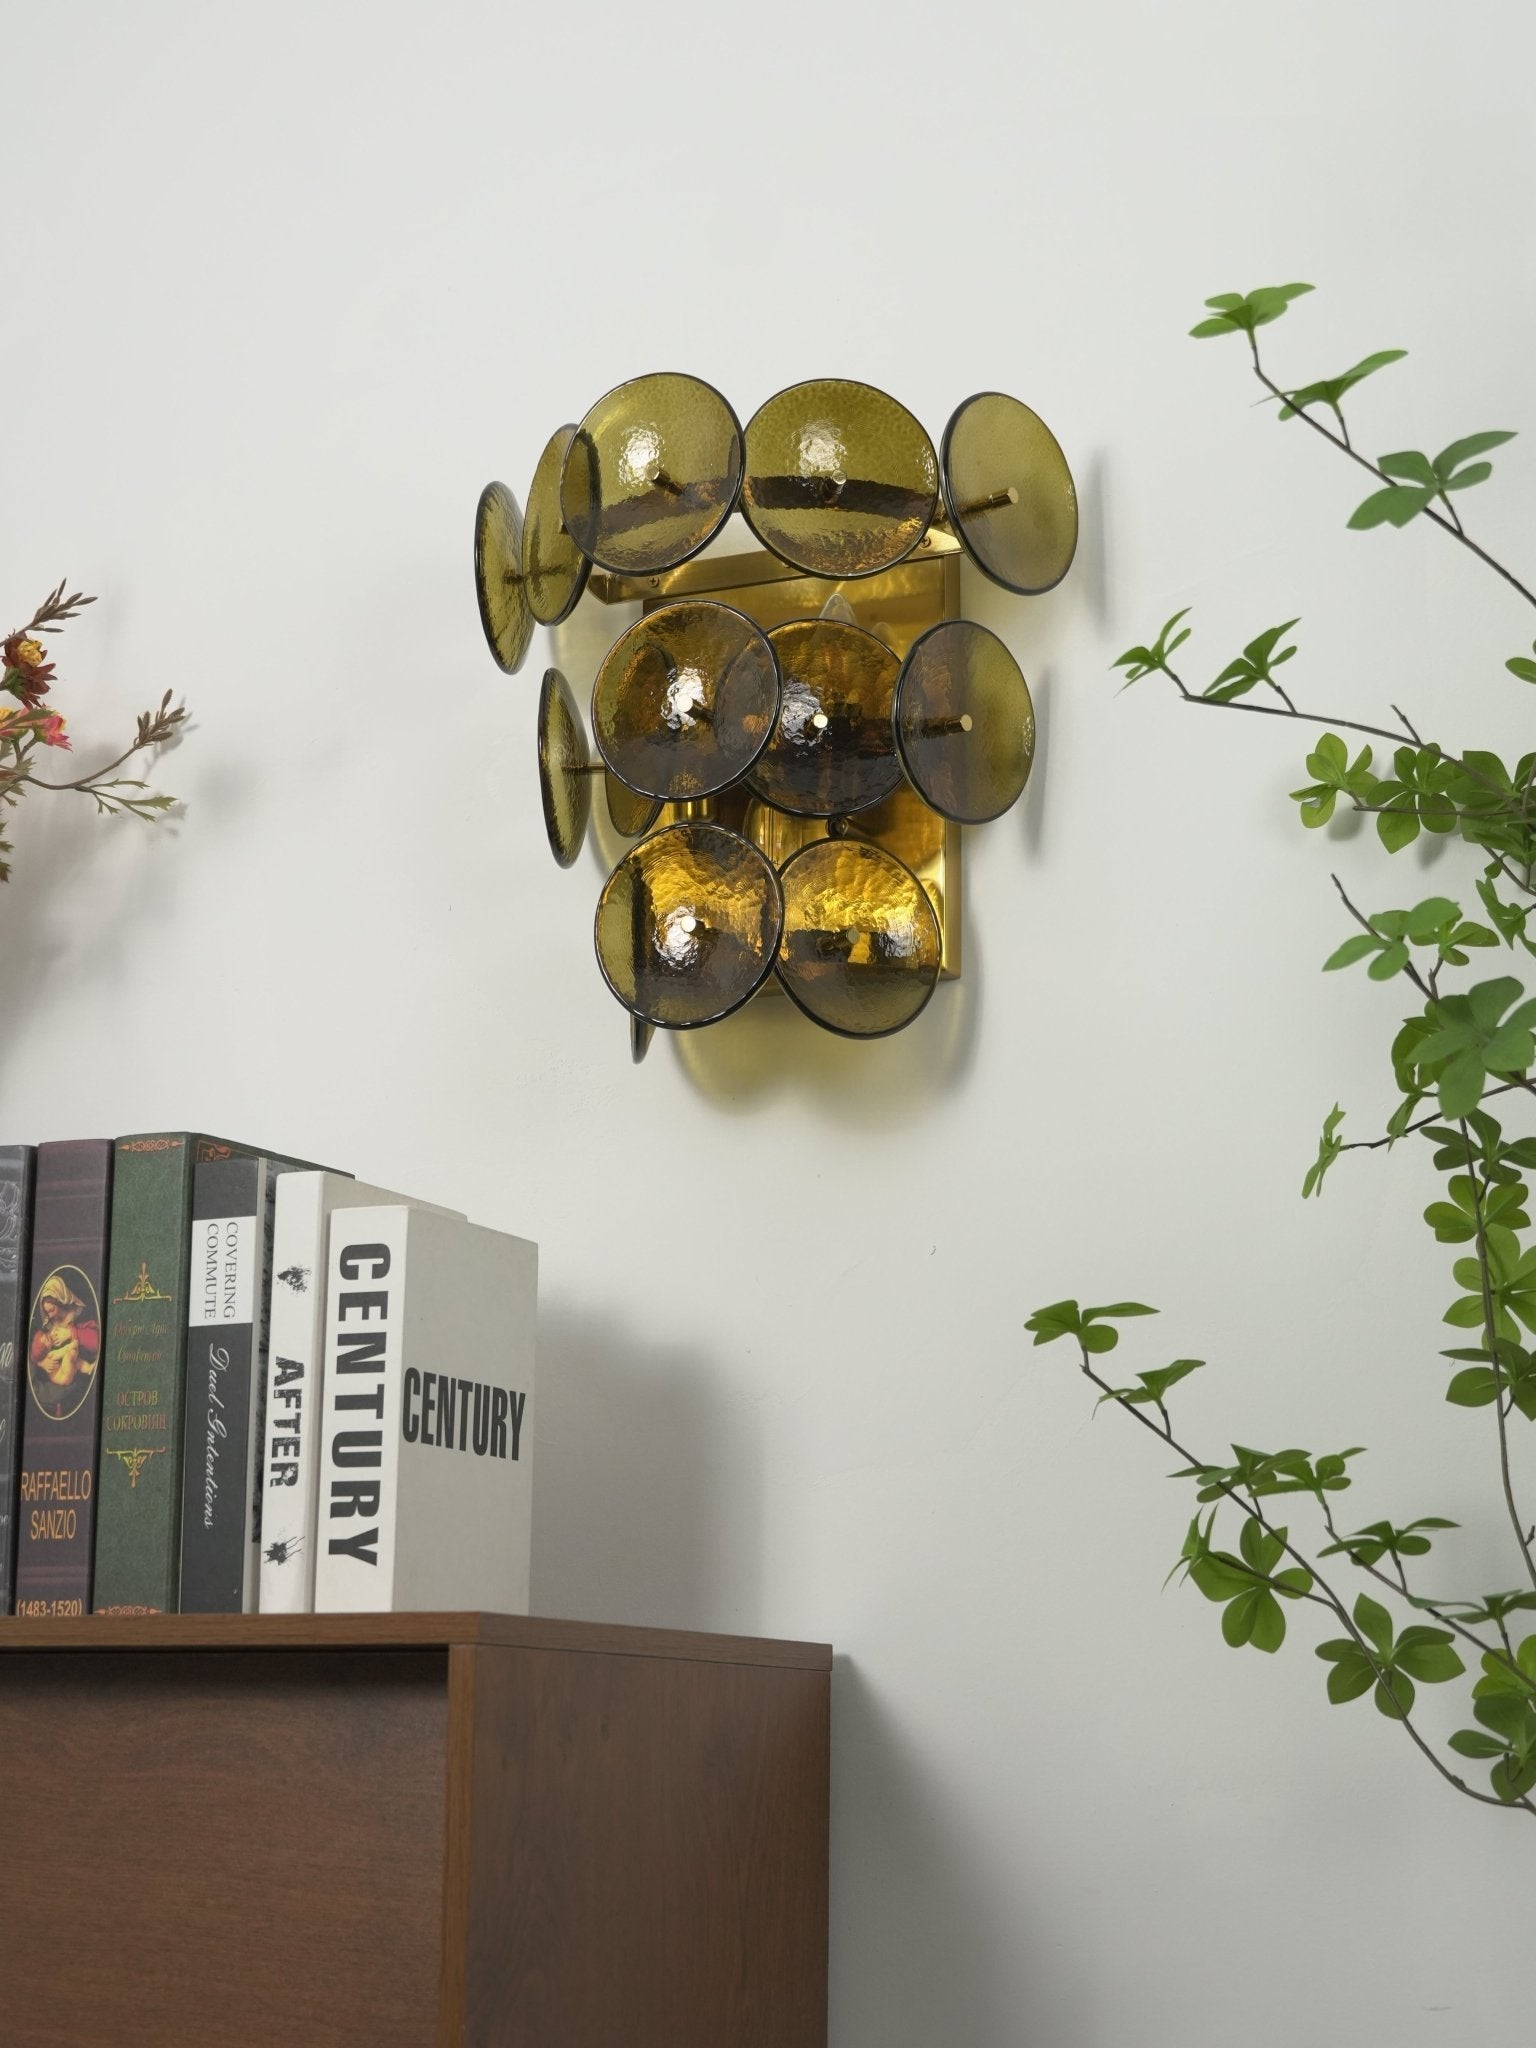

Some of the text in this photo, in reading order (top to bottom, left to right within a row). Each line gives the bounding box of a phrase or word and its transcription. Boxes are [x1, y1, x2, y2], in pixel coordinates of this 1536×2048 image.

[204, 1222, 219, 1319] COMMUTE
[223, 1221, 239, 1319] COVERING
[204, 1342, 230, 1530] Duel Intentions
[270, 1355, 305, 1488] AFTER
[328, 1243, 391, 1567] CENTURY
[402, 1366, 526, 1462] CENTURY
[21, 1469, 92, 1501] RAFFAELLO
[30, 1508, 77, 1541] SANZIO
[16, 1598, 82, 1617] (1483-1520)
